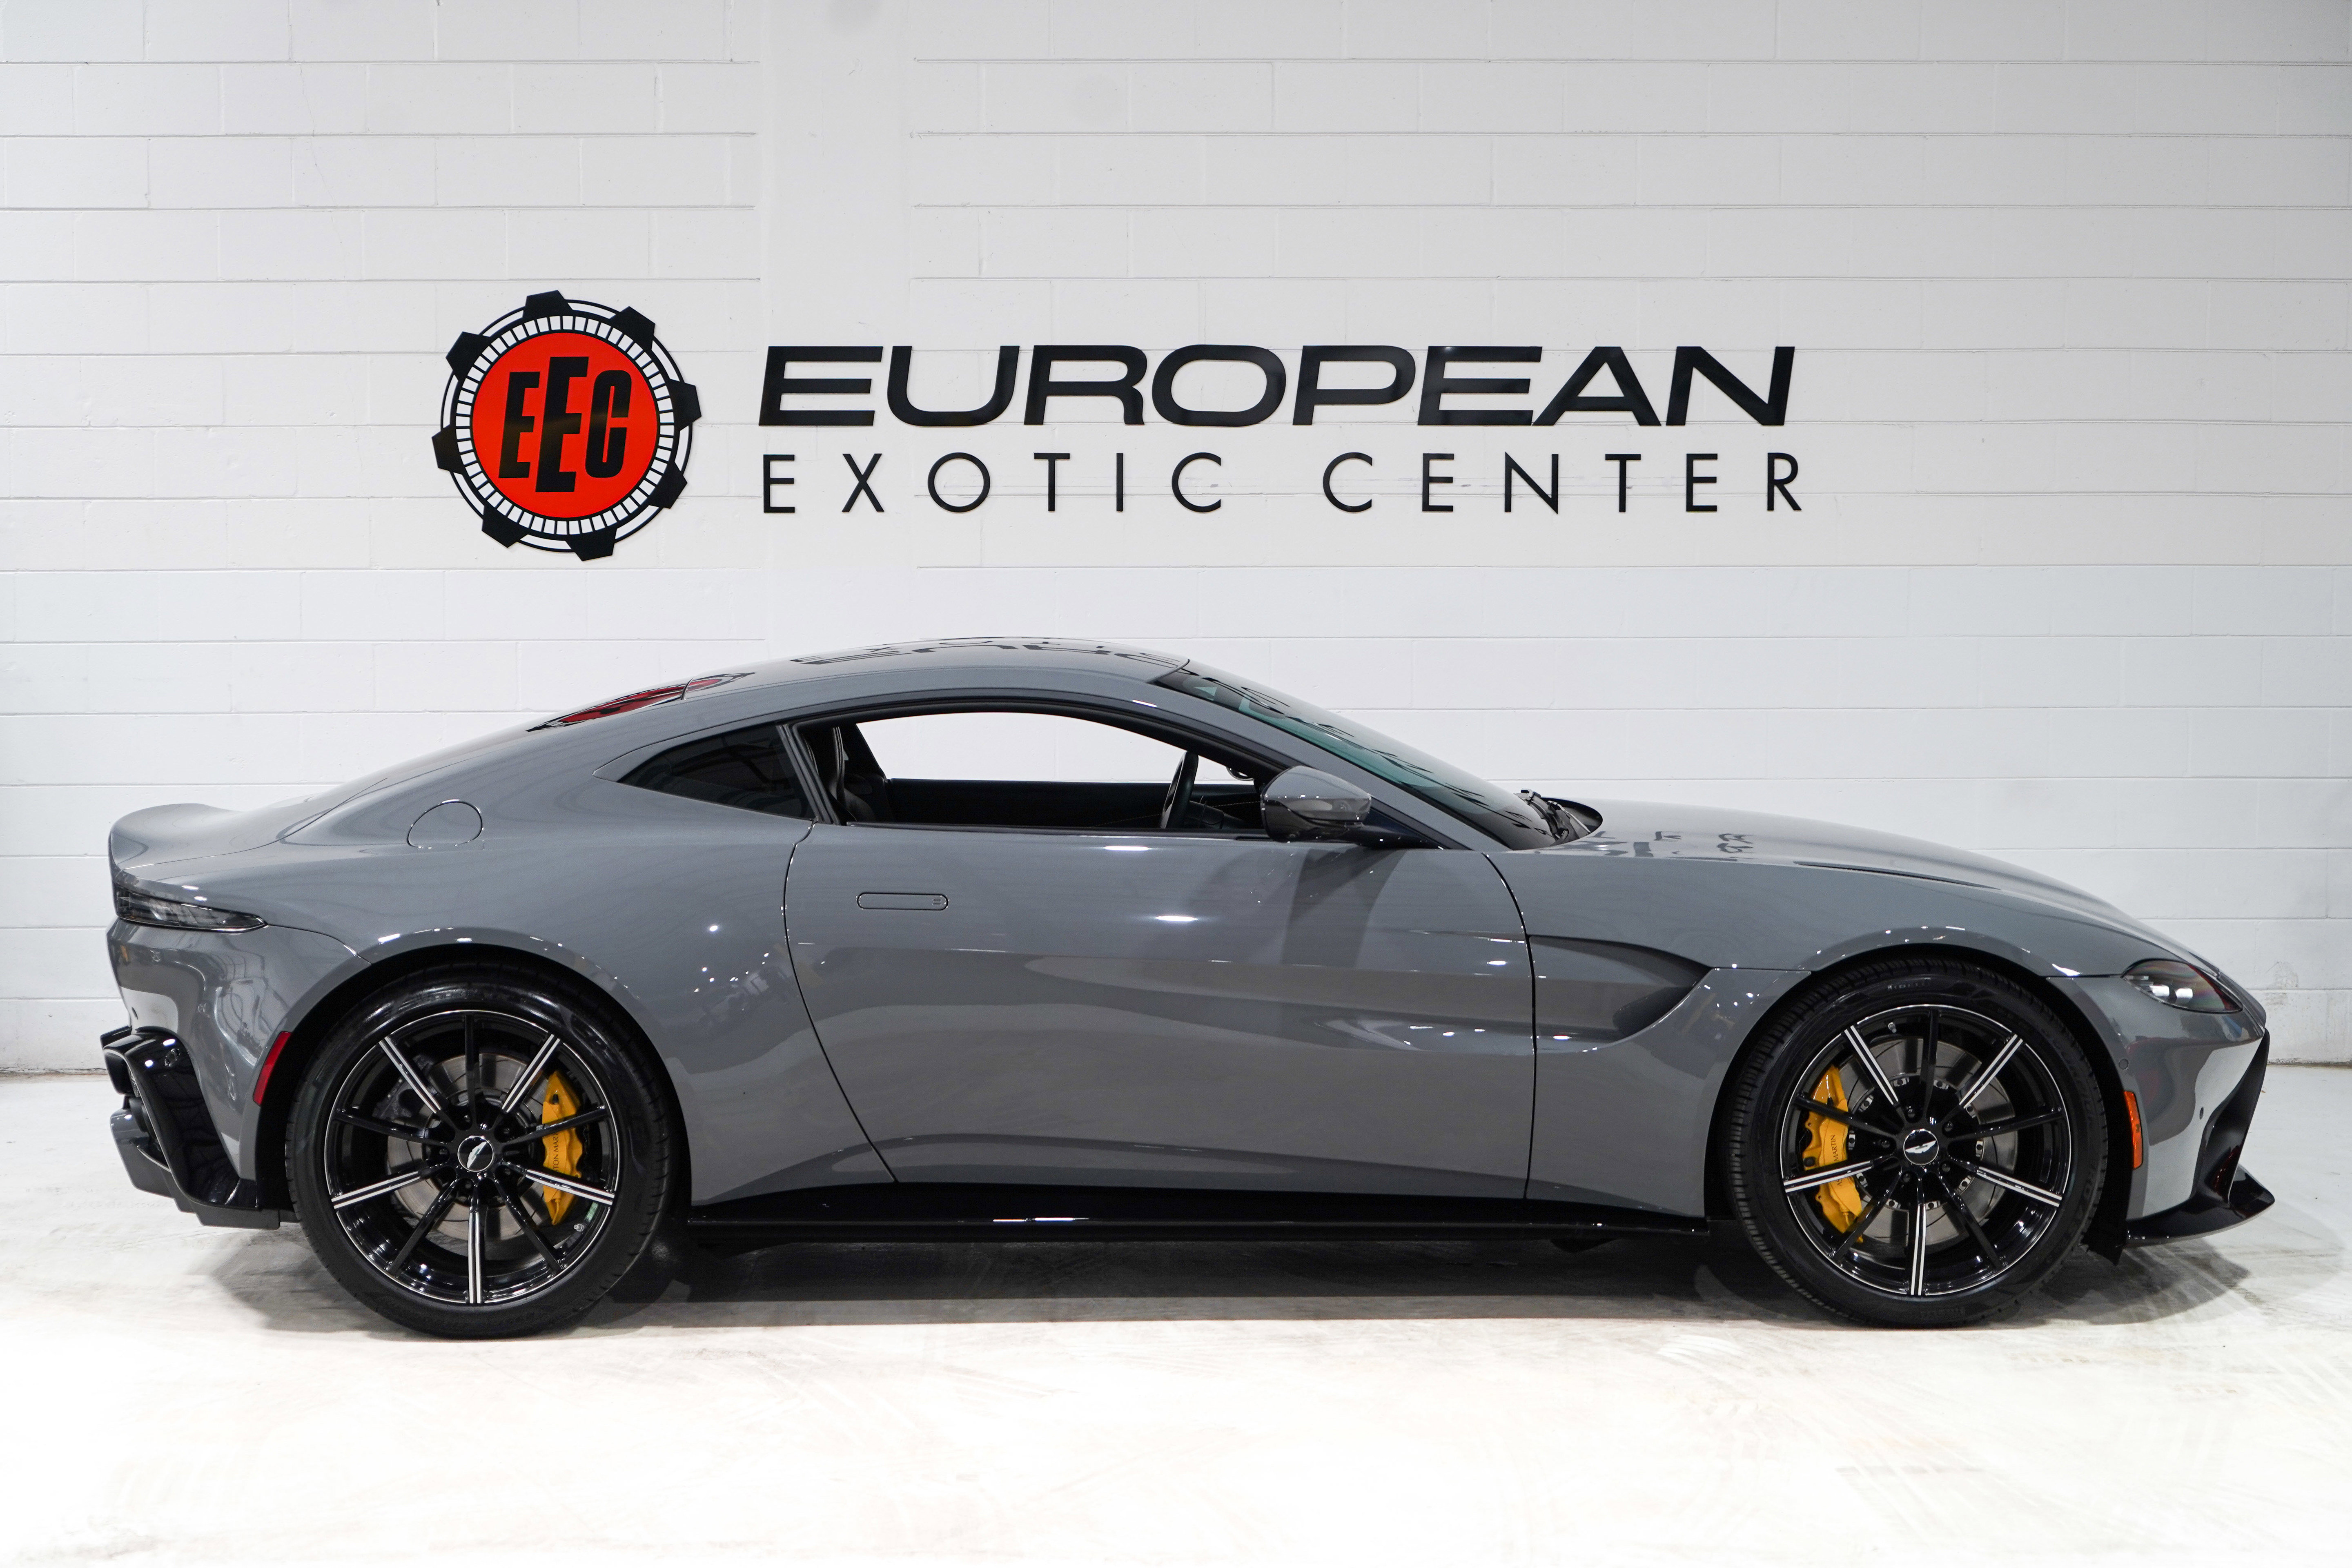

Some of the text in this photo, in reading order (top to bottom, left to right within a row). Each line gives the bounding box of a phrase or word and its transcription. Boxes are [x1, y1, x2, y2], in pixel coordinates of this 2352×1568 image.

[758, 345, 1795, 427] EUROPEAN
[498, 356, 633, 492] EEC
[763, 452, 1802, 513] EXOTIC CENTER
[1830, 1134, 1838, 1162] MARTIN
